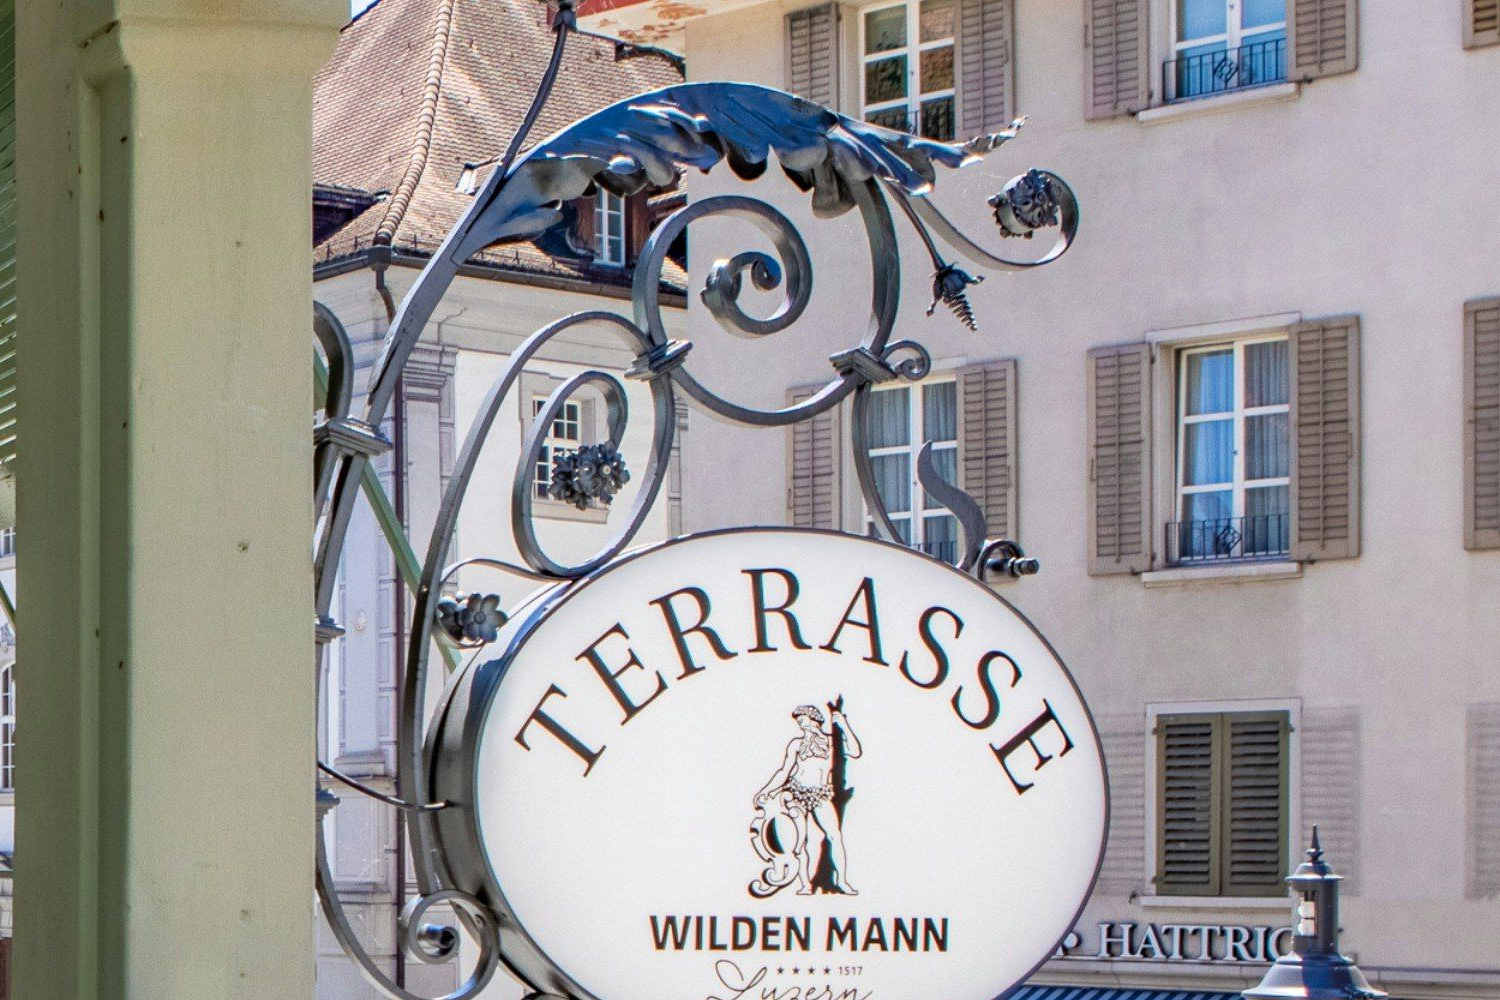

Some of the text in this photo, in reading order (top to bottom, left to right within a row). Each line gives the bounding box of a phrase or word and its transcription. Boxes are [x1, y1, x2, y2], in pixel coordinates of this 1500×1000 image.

[513, 566, 1075, 795] TERRASSE
[650, 915, 949, 953] WILDEN MANN
[1098, 922, 1340, 962] HATTRIC
[838, 965, 864, 976] 1517
